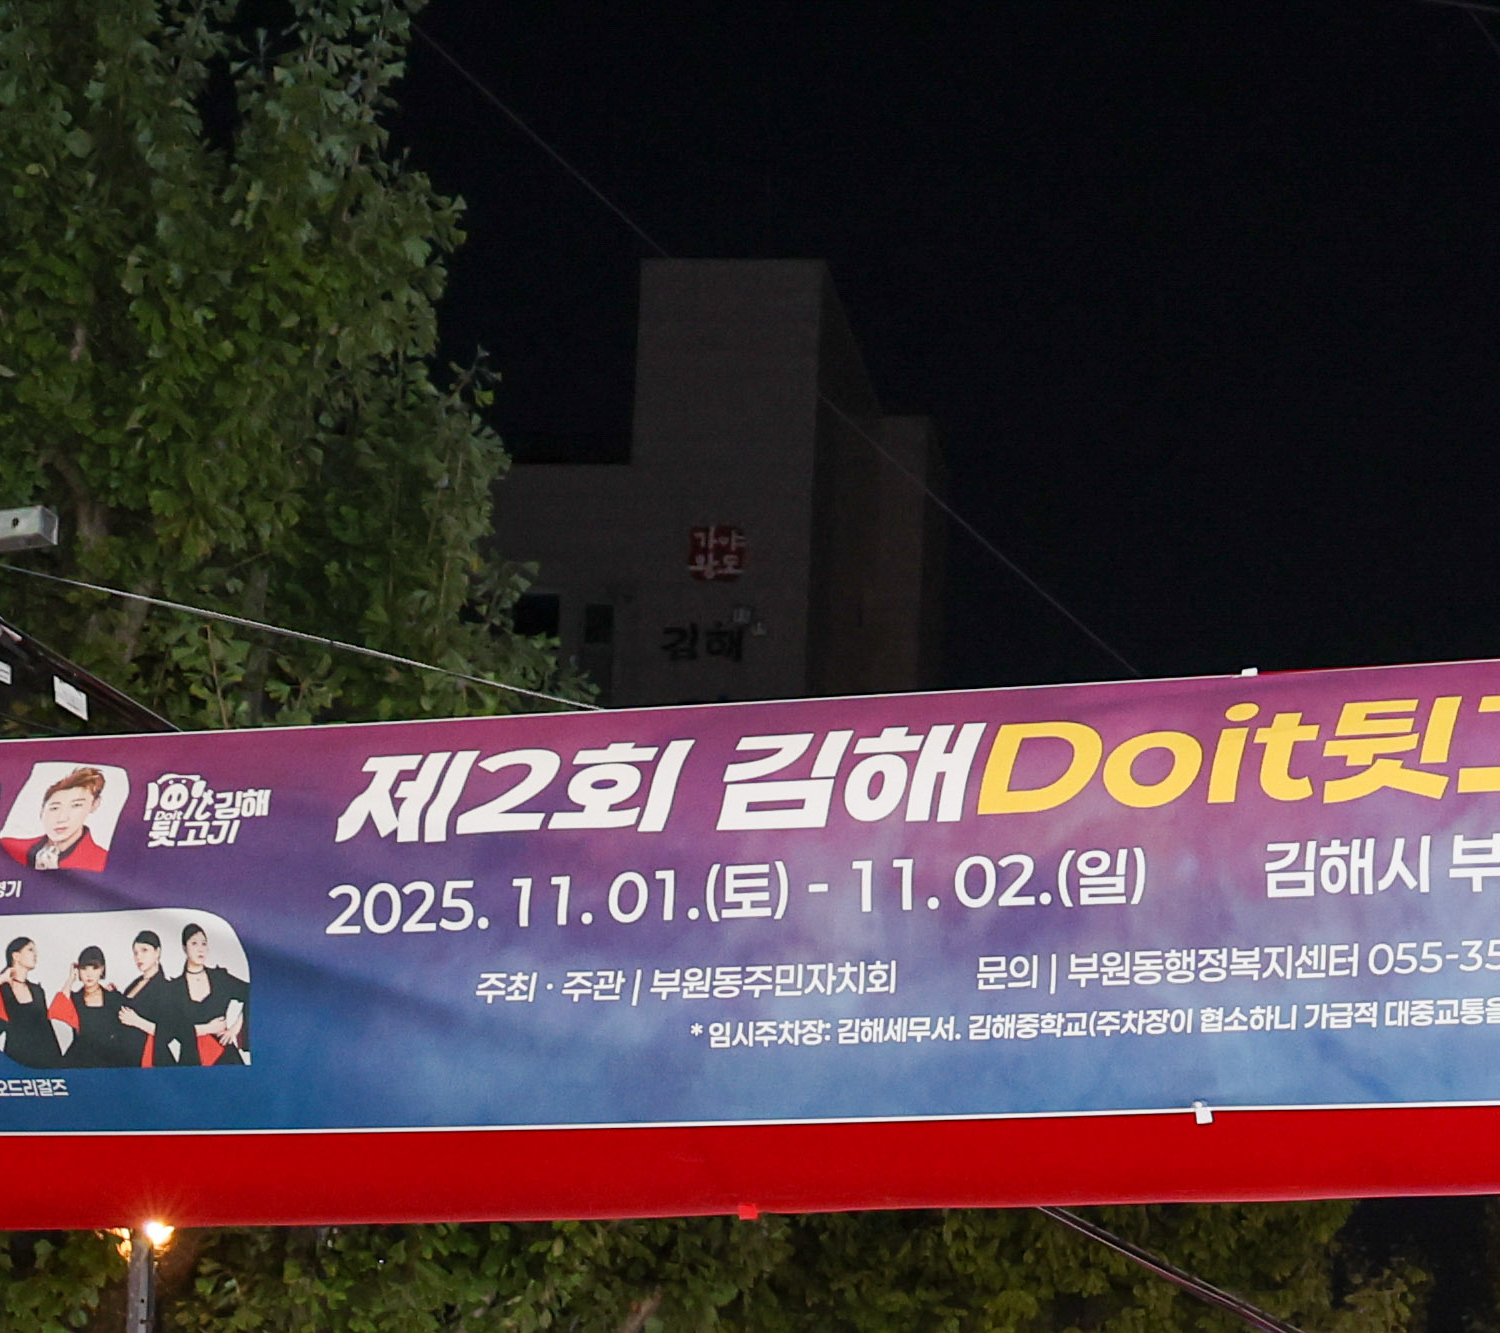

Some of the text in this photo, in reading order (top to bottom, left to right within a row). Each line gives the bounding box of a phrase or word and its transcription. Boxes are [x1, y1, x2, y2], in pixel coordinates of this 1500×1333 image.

[661, 622, 744, 662] 김해
[214, 789, 272, 820] 김해
[334, 740, 693, 843] 제2회
[147, 820, 240, 848] 뒷고기
[325, 878, 490, 935] 2025.
[1265, 836, 1431, 898] 김해시
[474, 971, 536, 1005] 주최
[561, 969, 626, 1002] 주관
[649, 959, 899, 1001] 부원동주민자치회
[976, 954, 1041, 991] 문의
[1067, 942, 1360, 990] 부원동행정복지센터
[708, 1018, 832, 1051] 임시주차장:
[968, 1007, 1193, 1041] 김해중학교(주차장이
[1199, 1005, 1297, 1034] 협소하니
[1303, 1001, 1378, 1030] 가급적
